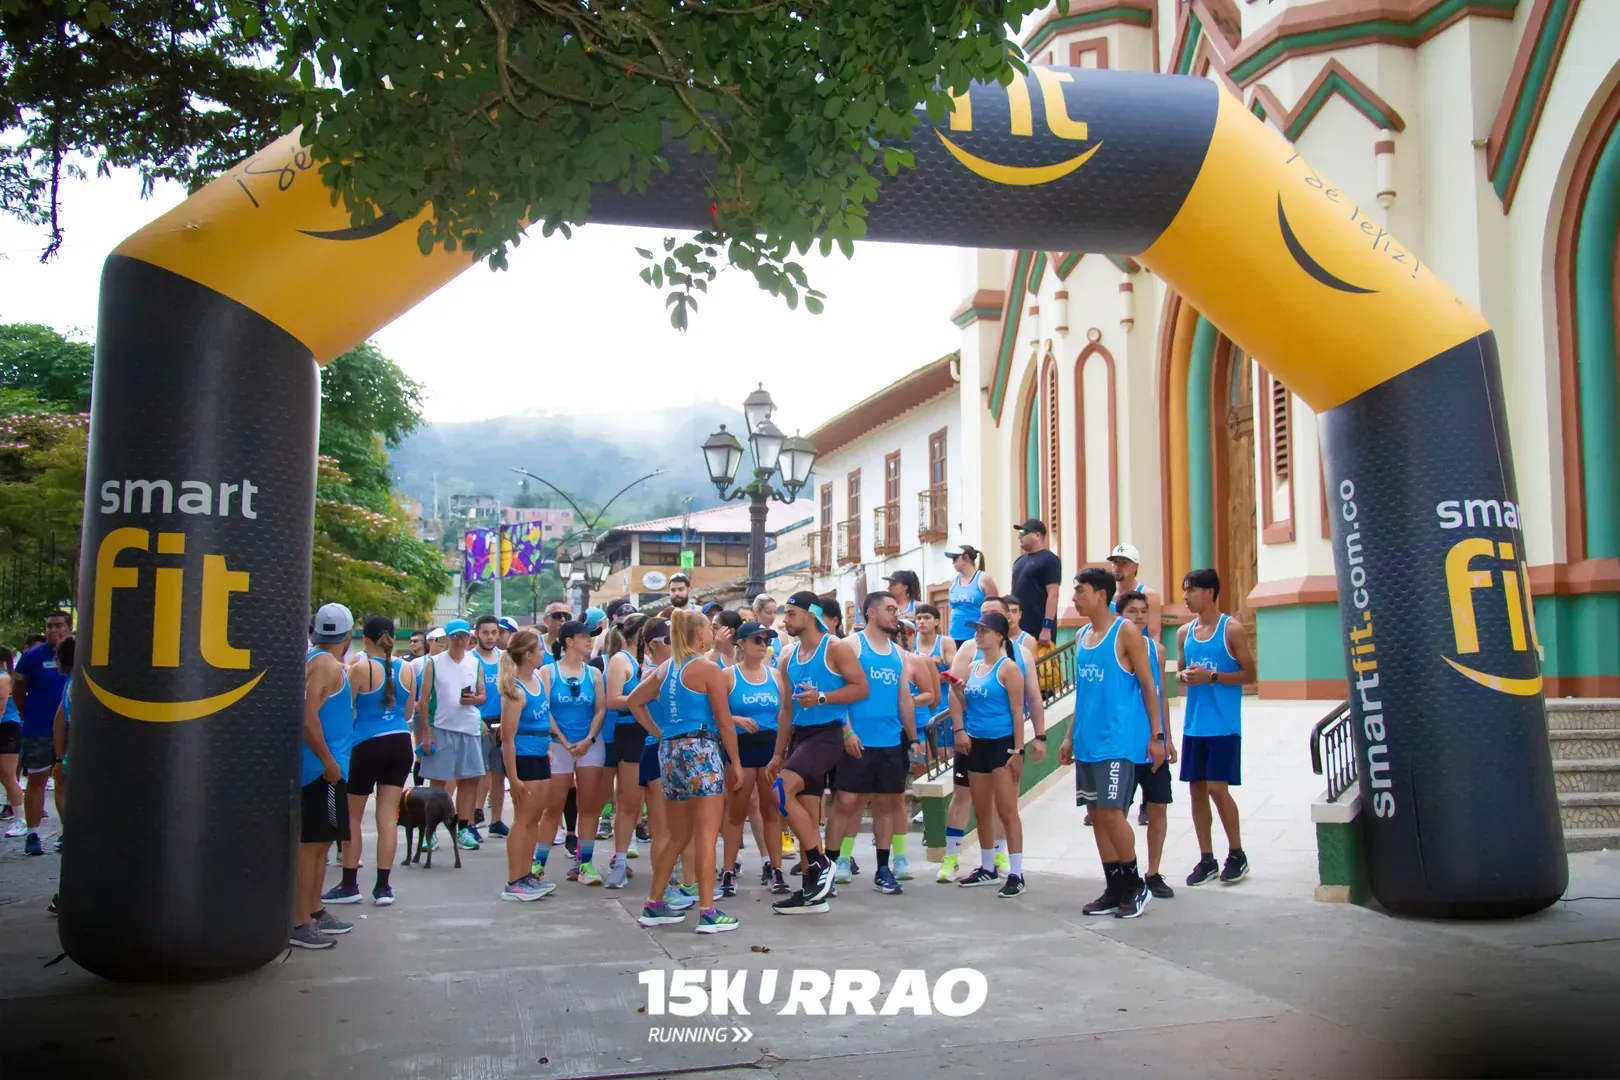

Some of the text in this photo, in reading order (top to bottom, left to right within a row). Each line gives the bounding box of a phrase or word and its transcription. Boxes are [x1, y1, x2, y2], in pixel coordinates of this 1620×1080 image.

[100, 478, 259, 519] smart
[90, 526, 251, 670] fit
[1340, 478, 1395, 819] smartfit.com.co
[870, 666, 899, 685] tonny
[742, 693, 779, 706] tonny
[1107, 761, 1120, 801] SUPER
